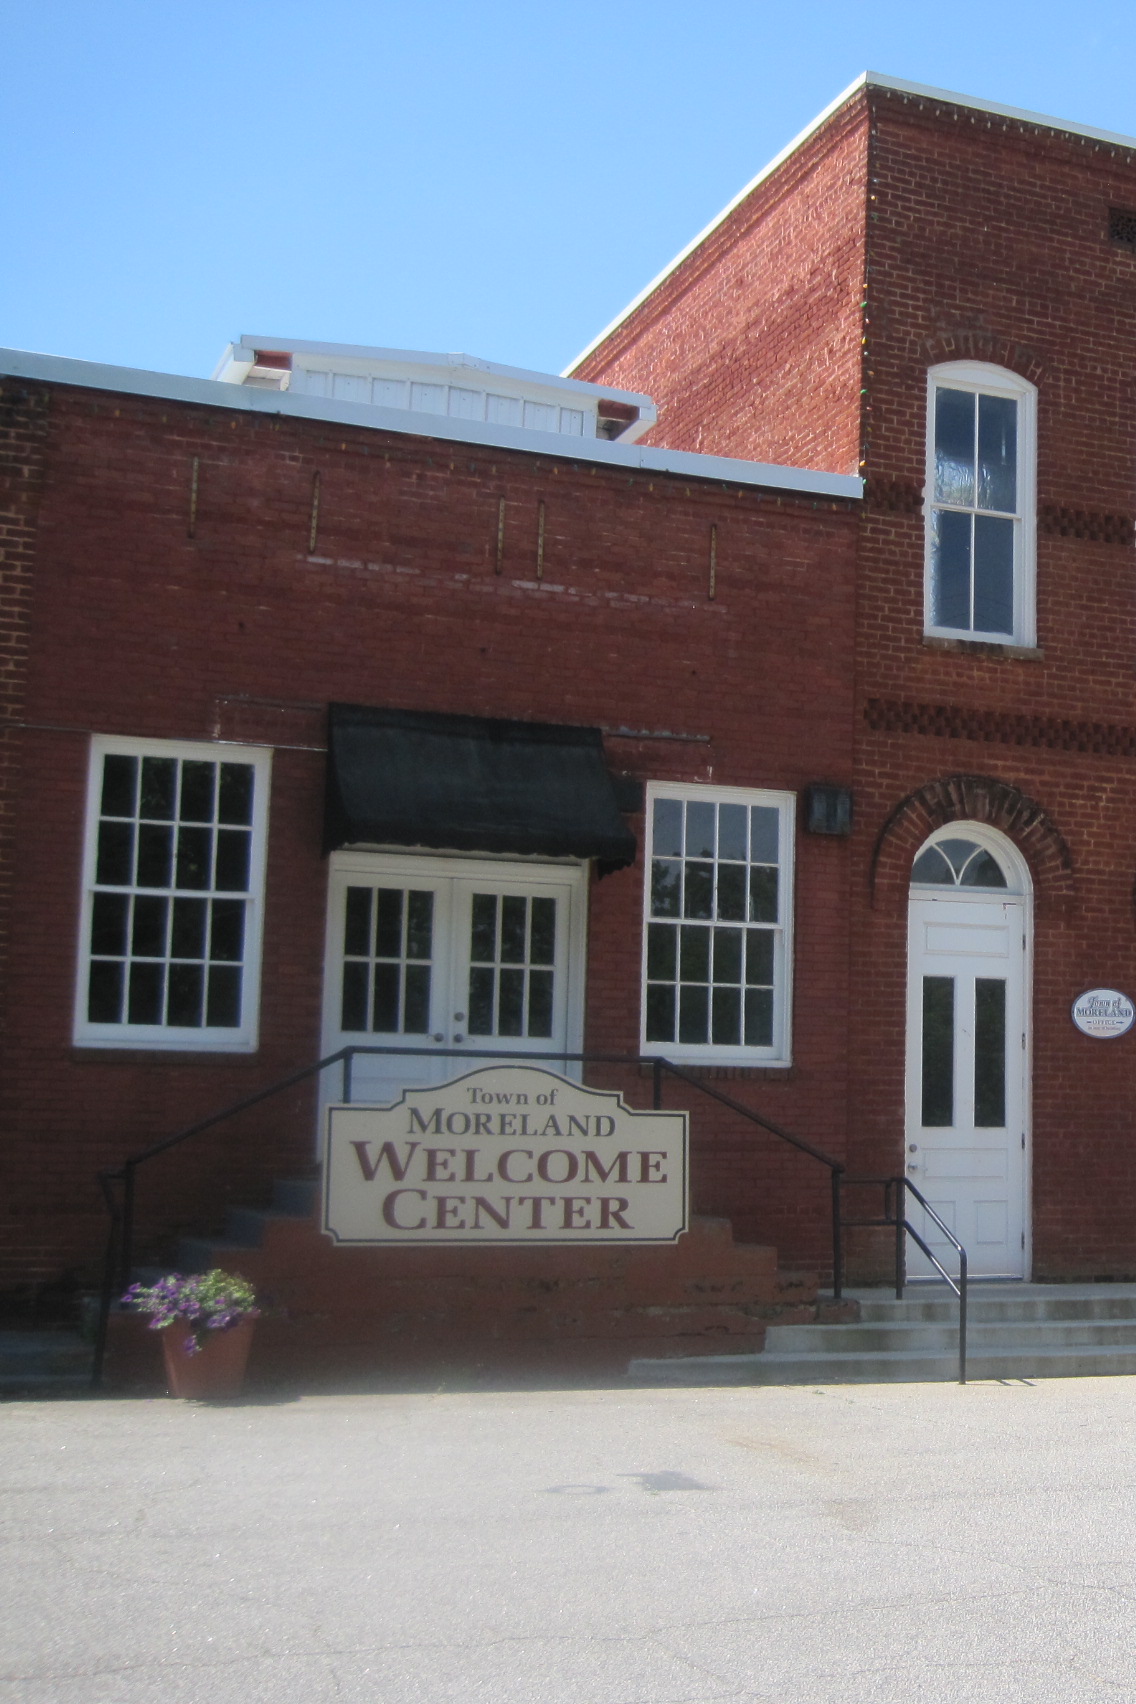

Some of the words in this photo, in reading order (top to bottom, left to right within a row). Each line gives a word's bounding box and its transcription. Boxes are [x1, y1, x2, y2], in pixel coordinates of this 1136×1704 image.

[1076, 1007, 1131, 1017] MORELAND
[1088, 995, 1110, 1008] Town
[467, 1087, 529, 1105] Town
[536, 1088, 559, 1106] of
[406, 1107, 616, 1137] MORELAND
[350, 1141, 668, 1183] WELCOME
[382, 1188, 635, 1230] CENTER
